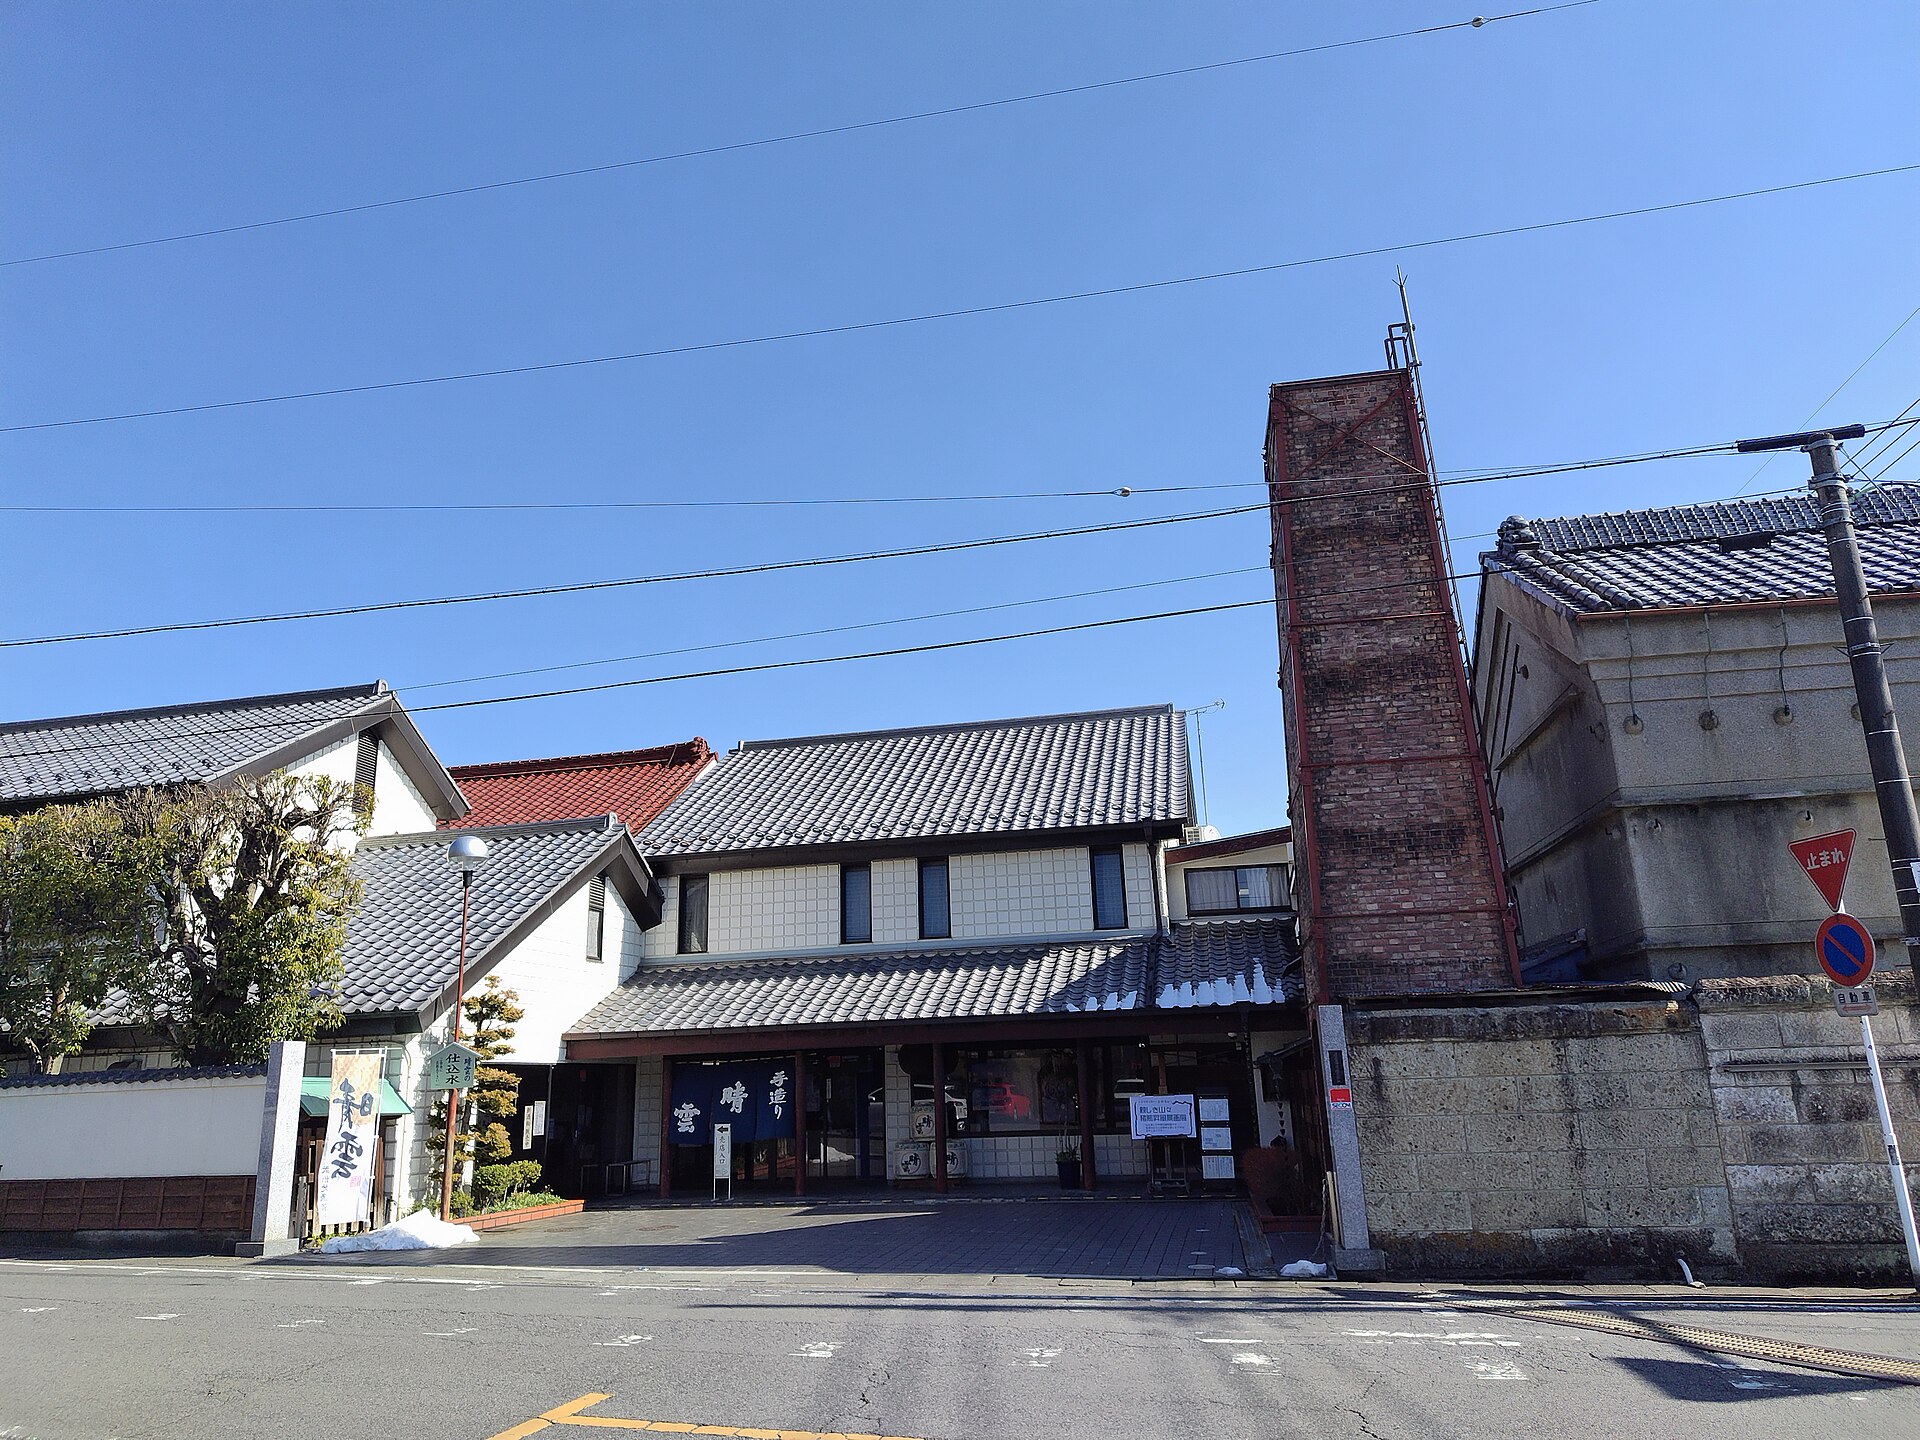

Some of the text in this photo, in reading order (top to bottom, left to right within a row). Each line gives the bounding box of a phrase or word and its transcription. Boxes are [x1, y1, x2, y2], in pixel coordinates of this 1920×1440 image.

[1806, 847, 1846, 870] 止まれ
[1837, 990, 1872, 1004] 自動車
[445, 1052, 461, 1085] 仕込水
[768, 1070, 789, 1120] 手造り
[718, 1135, 726, 1164] 売店入口
